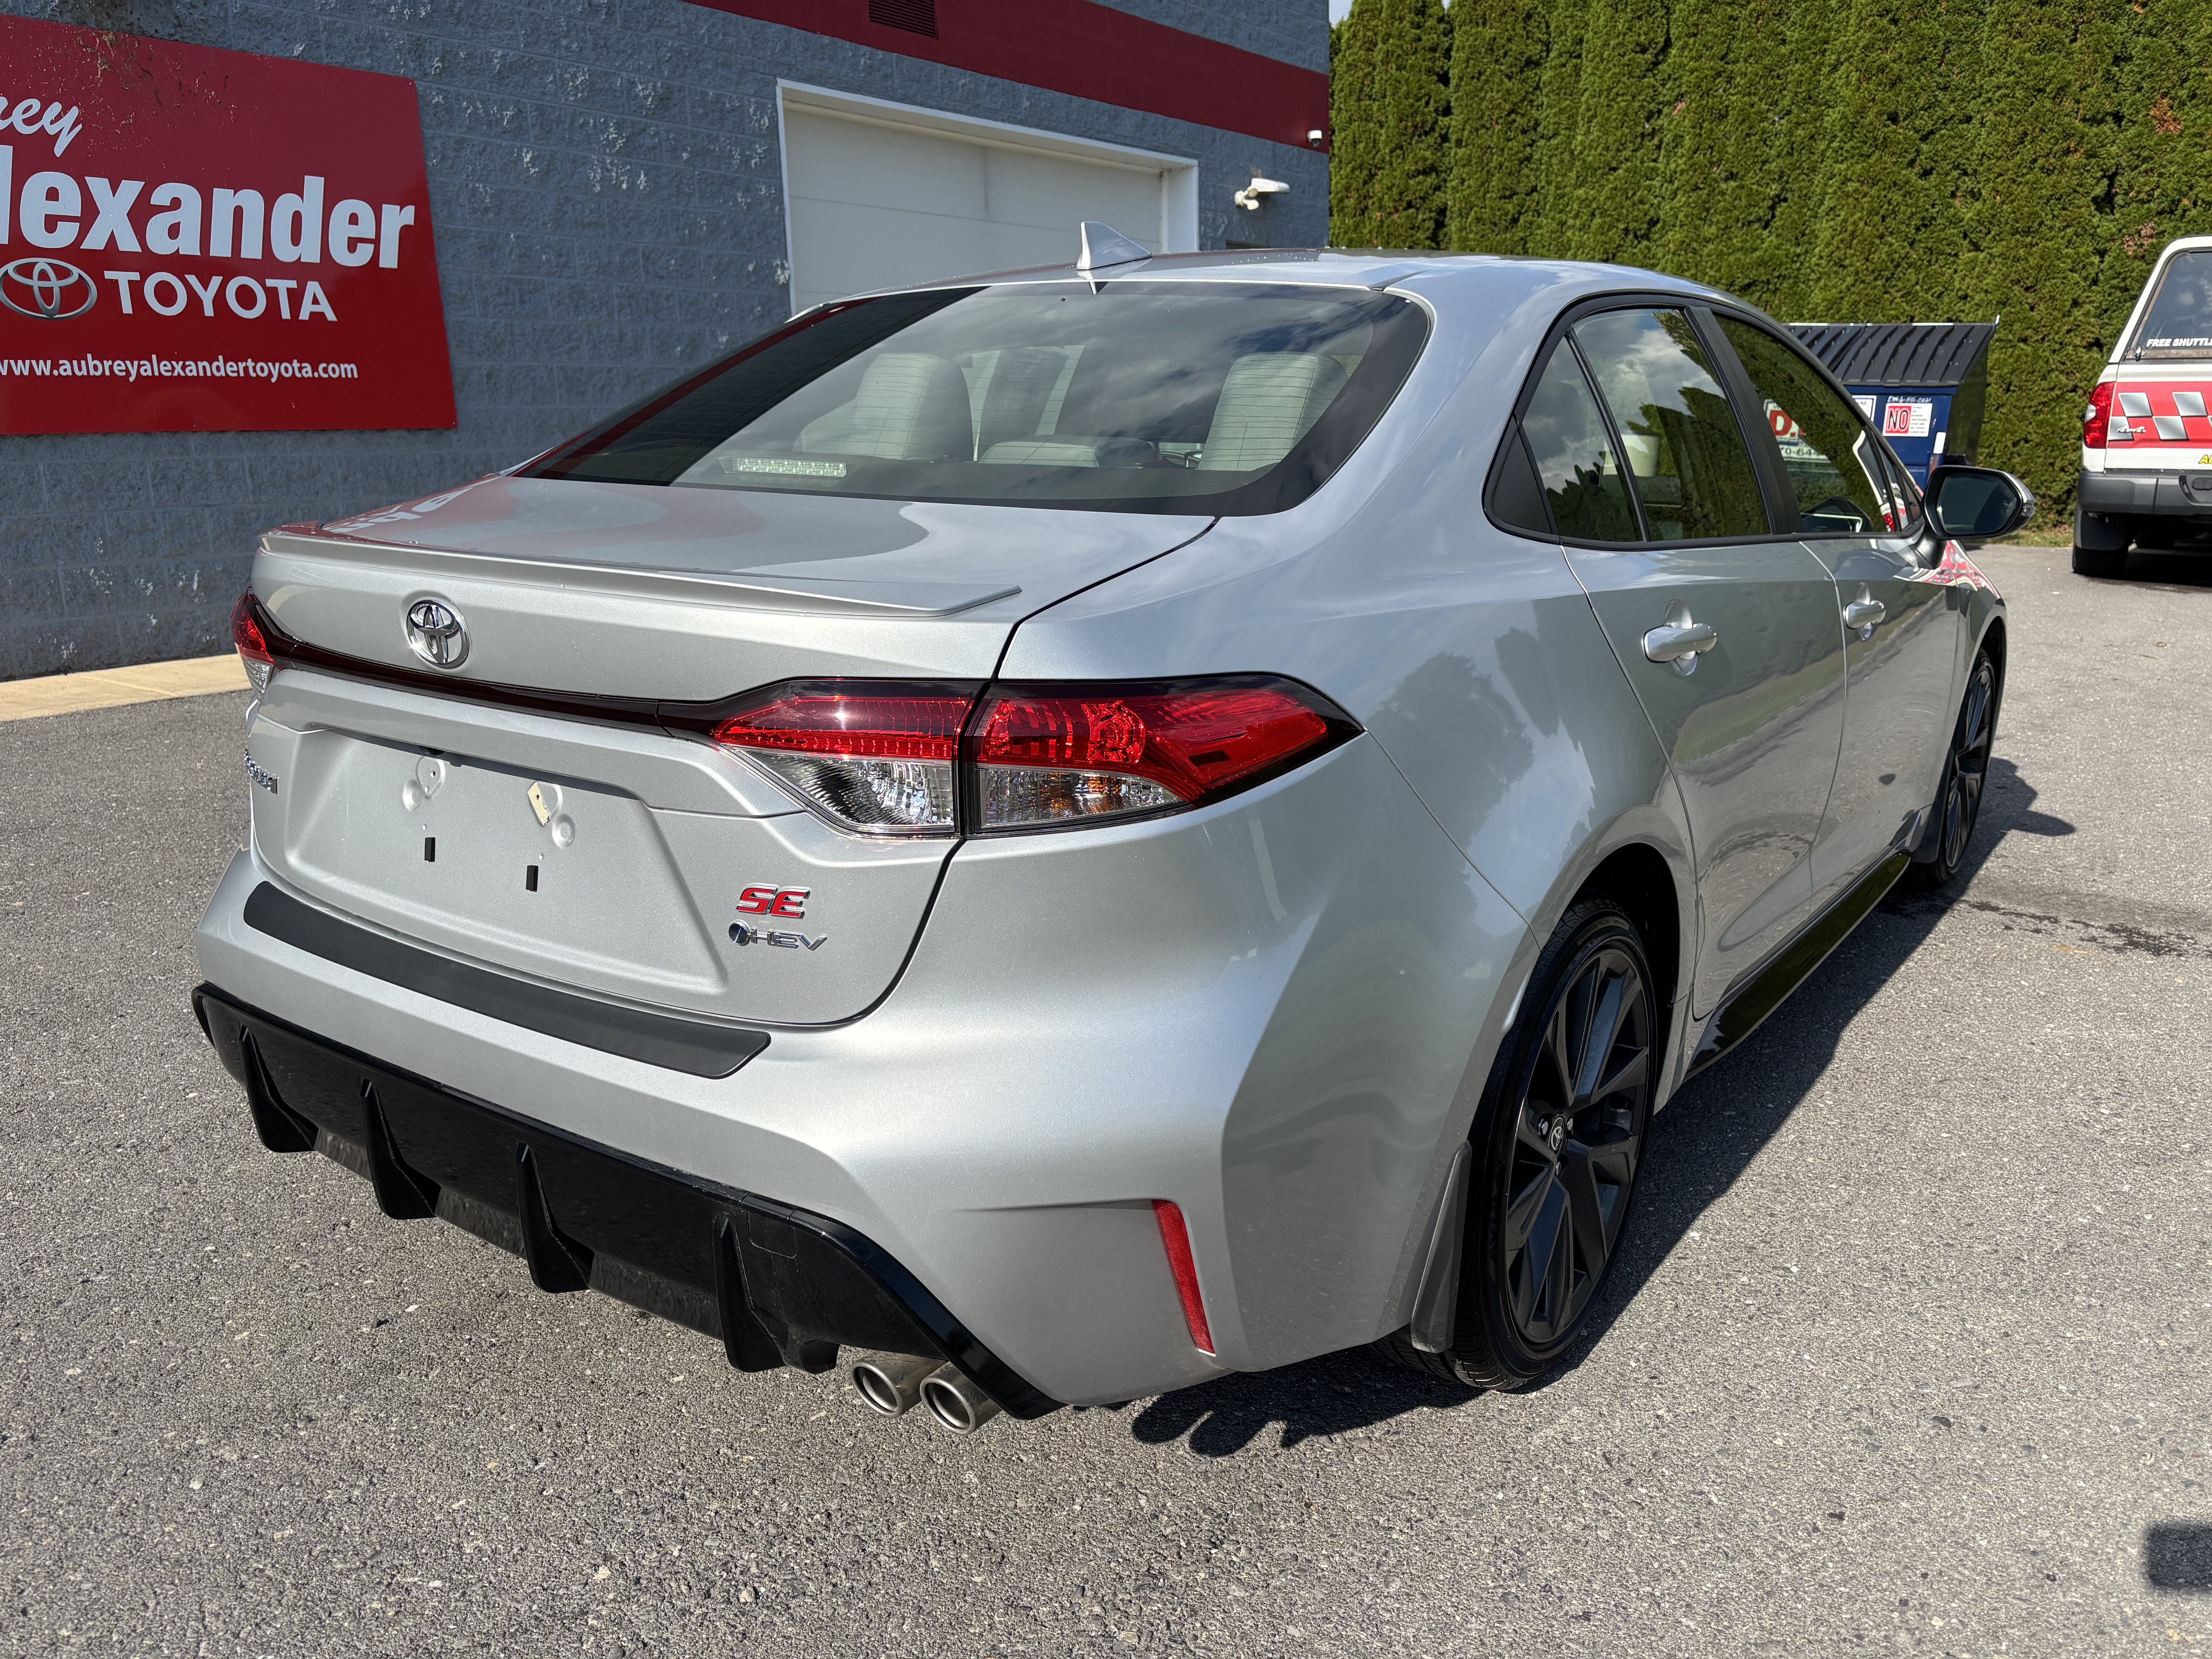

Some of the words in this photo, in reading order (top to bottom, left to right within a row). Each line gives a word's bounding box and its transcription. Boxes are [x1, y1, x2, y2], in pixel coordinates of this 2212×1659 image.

[104, 270, 337, 321] TOYOTA
[2146, 338, 2172, 347] FREE
[1887, 409, 1908, 431] NO
[736, 883, 811, 919] SE
[750, 928, 828, 951] HEV
